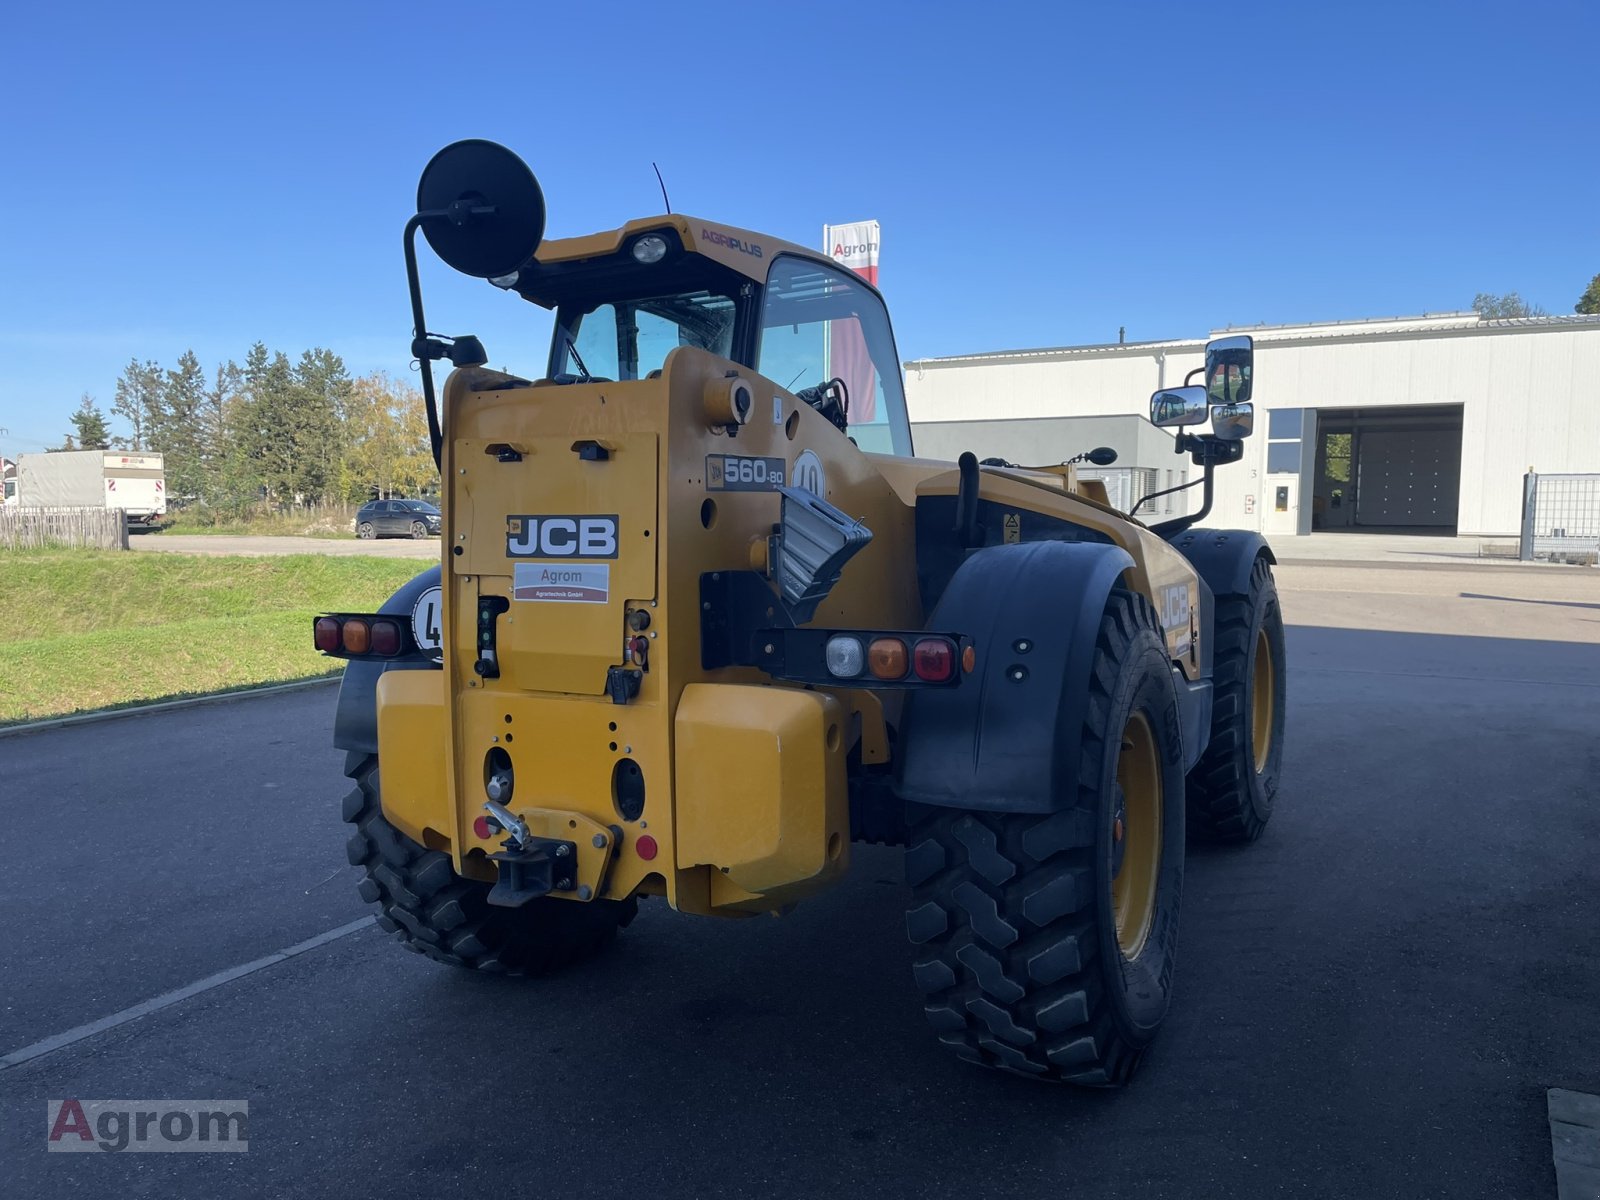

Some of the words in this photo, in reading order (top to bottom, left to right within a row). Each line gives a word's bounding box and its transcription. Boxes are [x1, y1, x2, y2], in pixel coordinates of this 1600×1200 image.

[702, 228, 763, 258] AGRIPLUS
[833, 242, 878, 257] Agrom
[508, 518, 616, 555] JCB
[541, 569, 582, 585] Agrom
[536, 590, 567, 598] Agrartechnik
[1161, 586, 1189, 629] JCB
